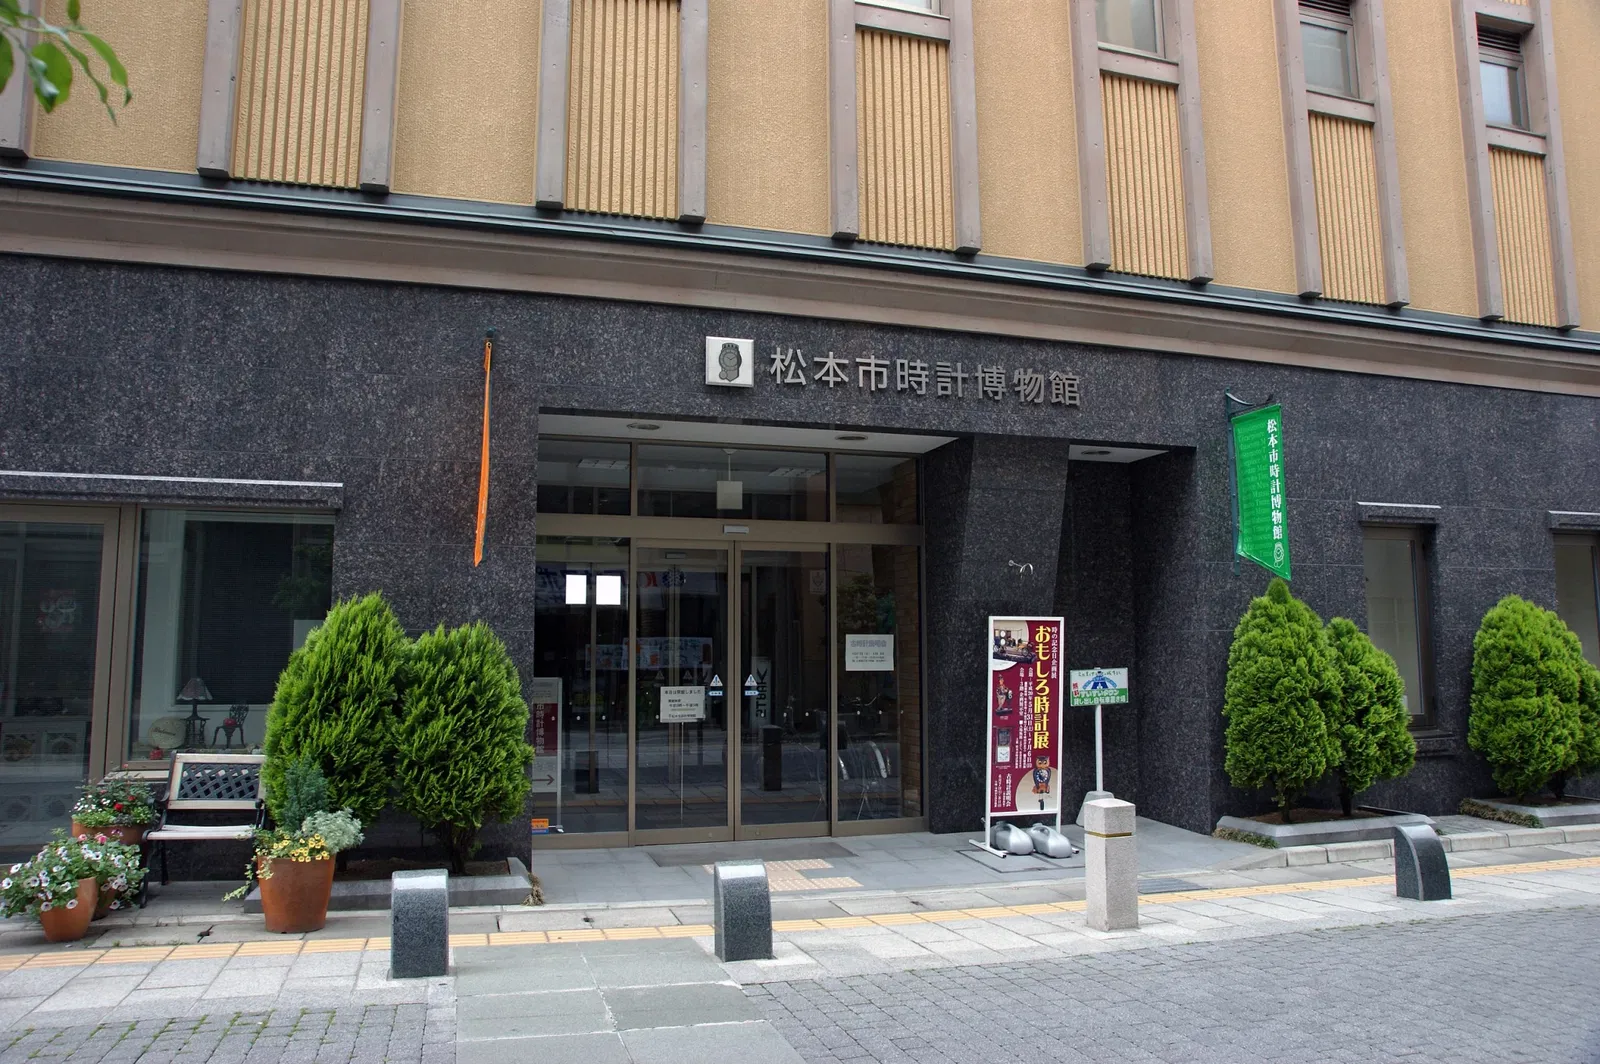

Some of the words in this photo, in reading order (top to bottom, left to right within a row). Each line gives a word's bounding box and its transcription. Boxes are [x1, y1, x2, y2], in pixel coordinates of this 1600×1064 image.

[769, 347, 1081, 406] 松本市時計博物館
[1267, 418, 1283, 540] 松本市時計博物館
[1034, 625, 1050, 749] おもしろ時計展
